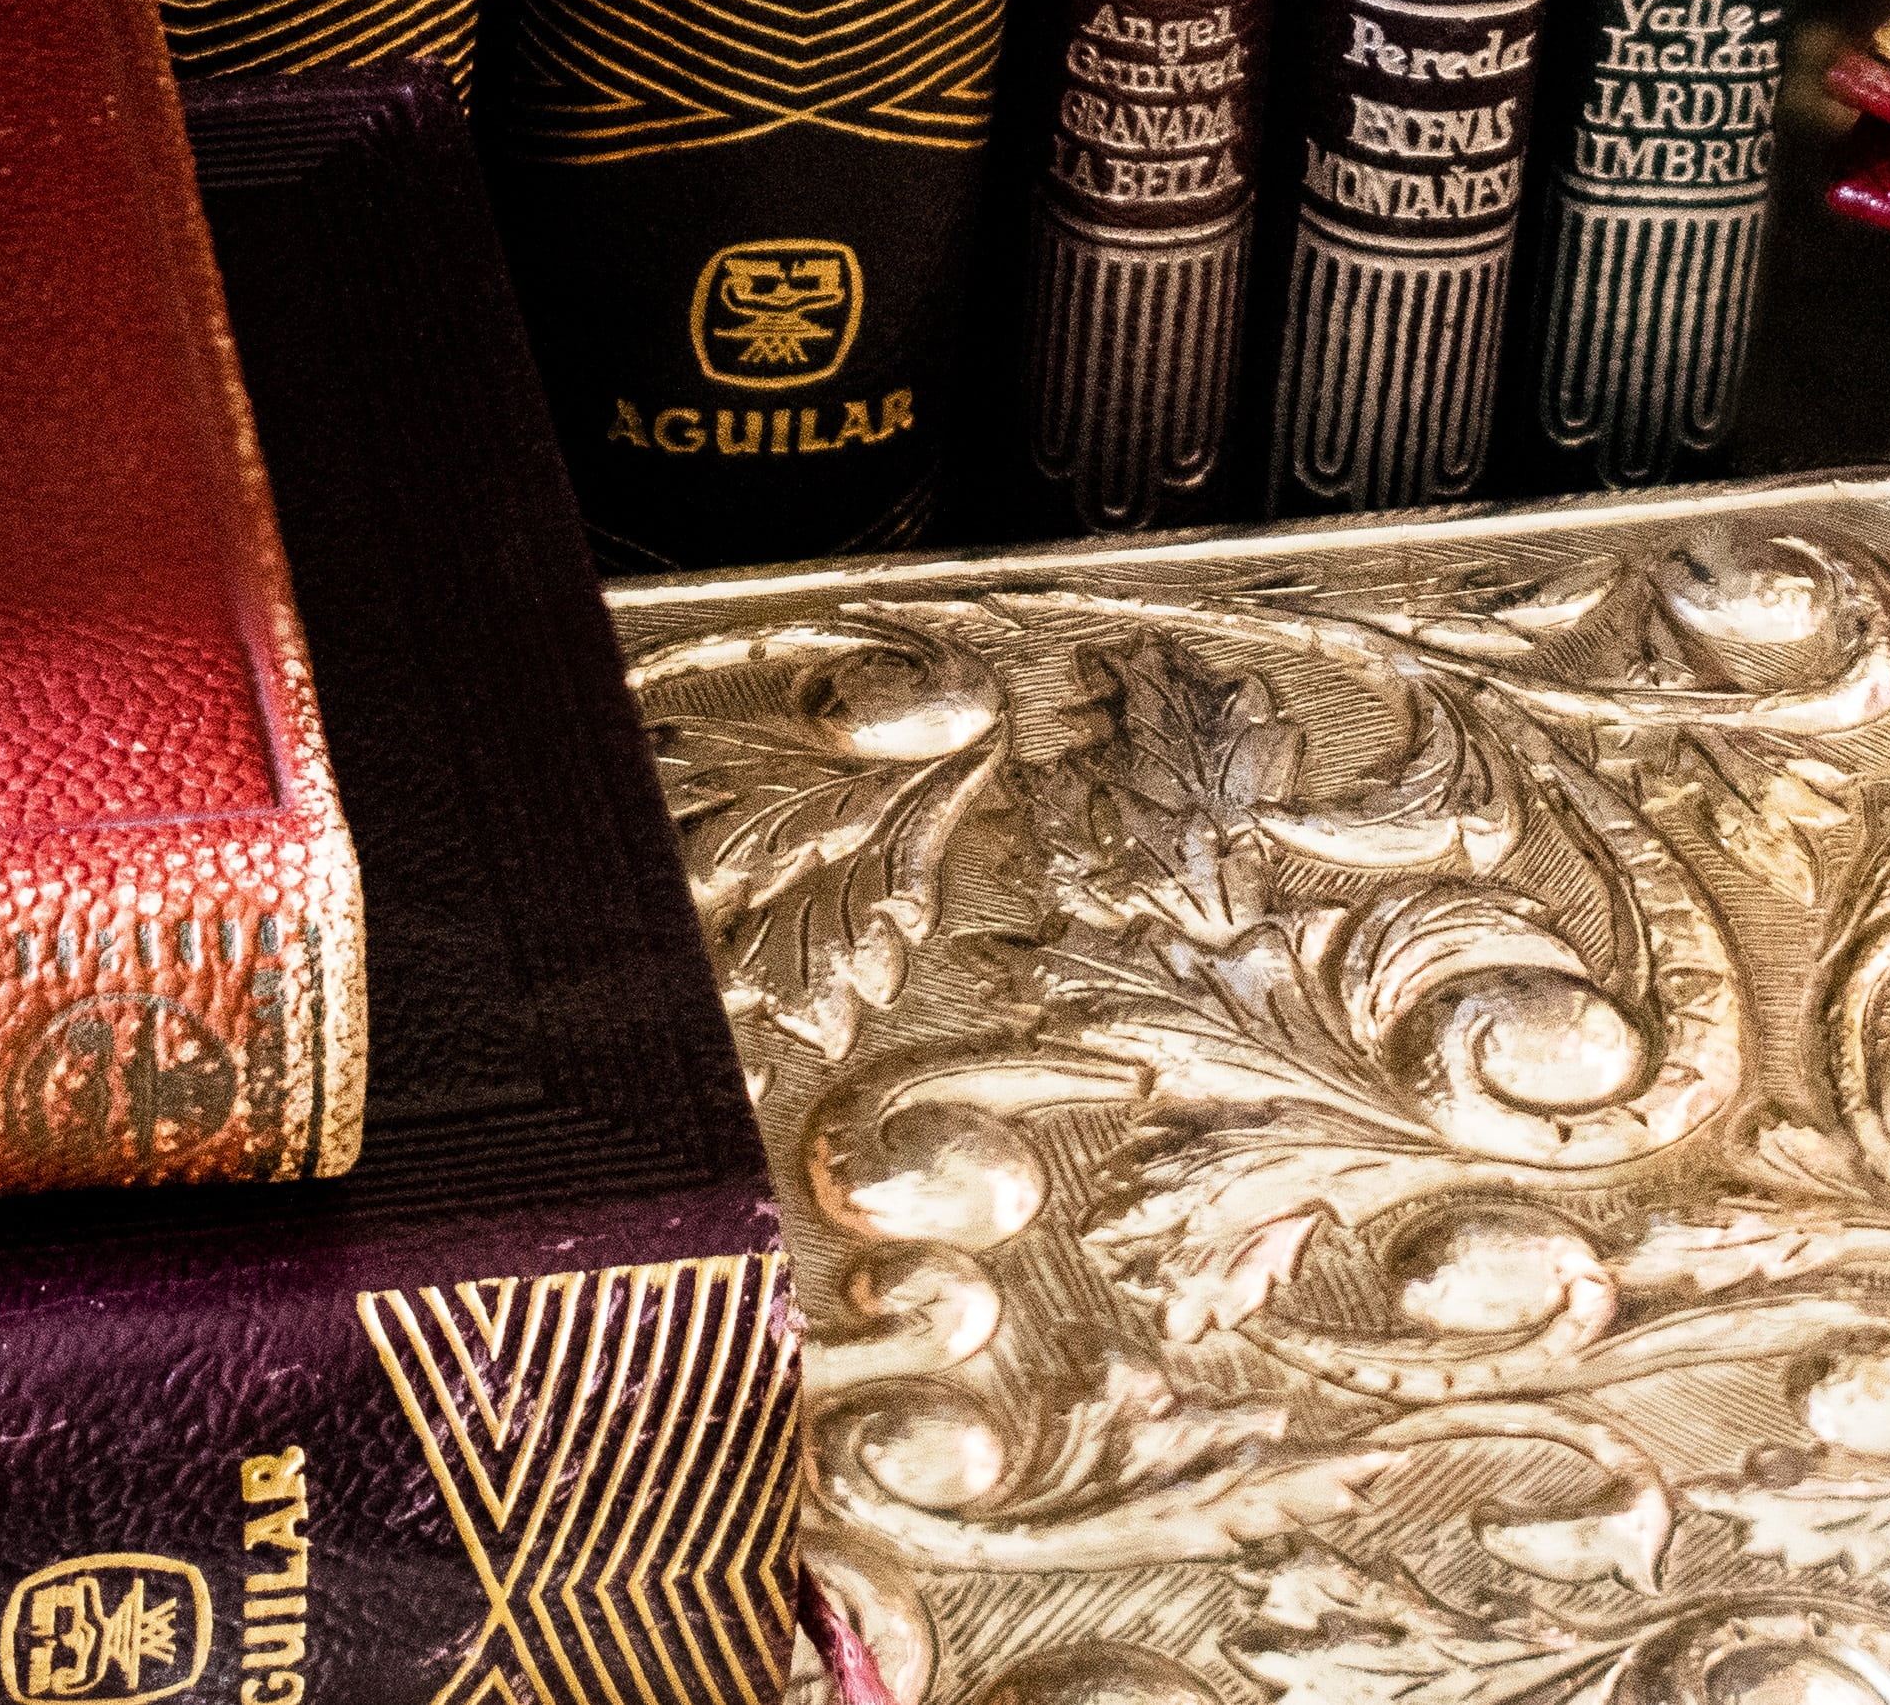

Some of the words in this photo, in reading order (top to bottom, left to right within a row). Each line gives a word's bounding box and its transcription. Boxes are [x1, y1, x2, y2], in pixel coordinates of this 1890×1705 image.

[1080, 3, 1237, 66] Angel
[1341, 13, 1538, 80] Pereda
[1596, 25, 1781, 74] Inclán
[1061, 89, 1242, 151] GRANADA
[1346, 94, 1517, 158] ESCENAS
[1583, 73, 1782, 130] JARDIN
[1106, 147, 1246, 202] BELLA
[607, 388, 915, 456] AGUILAR
